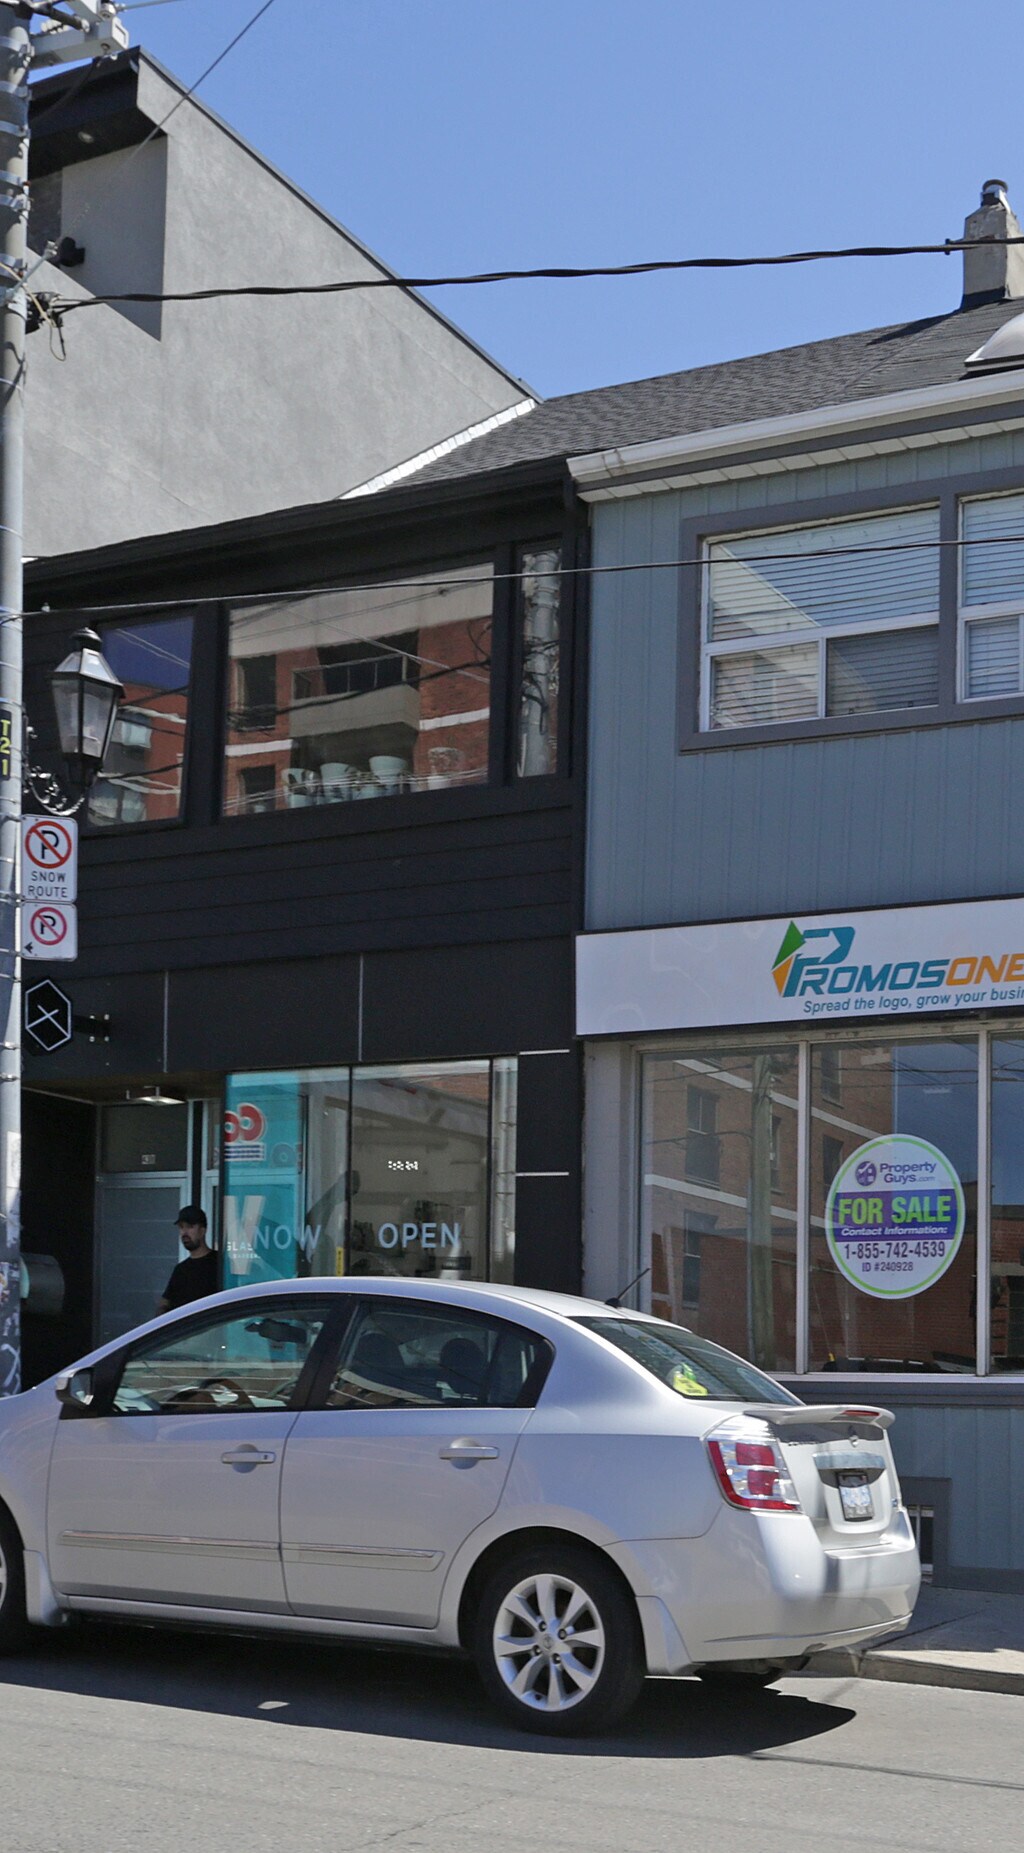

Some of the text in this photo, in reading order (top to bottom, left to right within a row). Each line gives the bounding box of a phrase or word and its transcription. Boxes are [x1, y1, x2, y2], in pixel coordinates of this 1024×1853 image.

[31, 870, 66, 882] SNOW
[28, 886, 67, 898] ROUTE
[803, 999, 850, 1015] Spread
[854, 999, 875, 1010] the
[878, 996, 912, 1011] logo,
[918, 994, 951, 1009] grow
[954, 991, 986, 1007] your
[880, 1161, 937, 1174] Property
[838, 1195, 952, 1226] FOR SALE
[254, 1222, 460, 1250] NOW OPEN
[841, 1226, 948, 1237] Contact Information:
[844, 1241, 946, 1260] 1-855-742-4539
[862, 1261, 914, 1272] ID #240928
